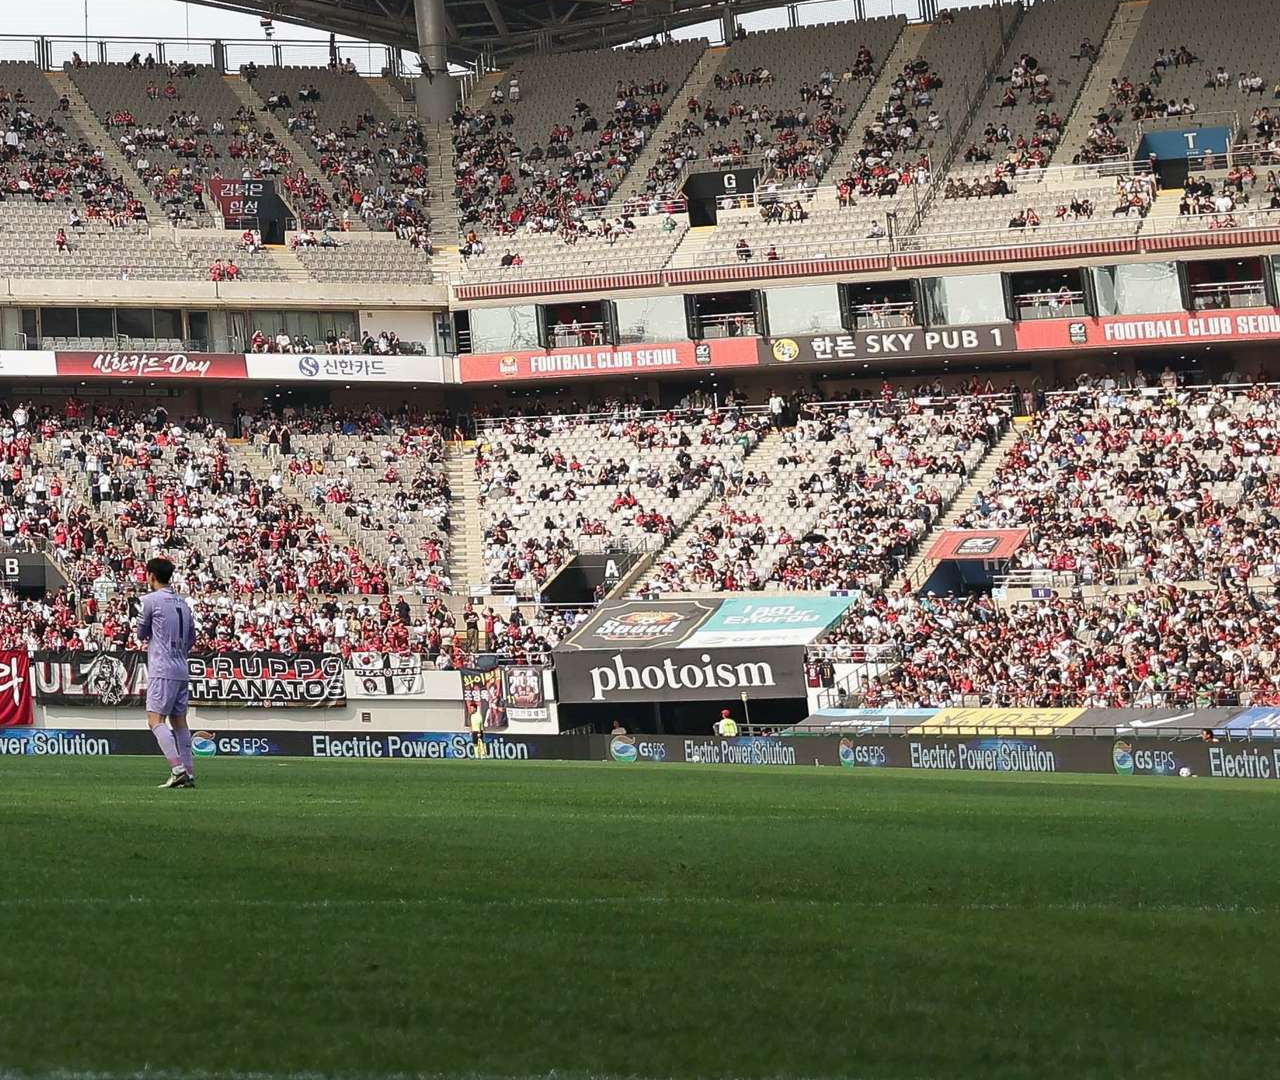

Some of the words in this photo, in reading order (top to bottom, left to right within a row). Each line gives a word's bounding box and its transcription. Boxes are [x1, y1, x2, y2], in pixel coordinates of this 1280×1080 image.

[1184, 132, 1197, 148] T
[723, 173, 736, 188] G
[1104, 321, 1185, 341] FOOTBALL
[1188, 317, 1232, 336] CLUB
[811, 336, 857, 359] 한돈
[866, 333, 914, 353] SKY
[925, 329, 979, 350] PUB
[989, 328, 1003, 346] 1
[93, 352, 162, 376] 신한카드
[164, 353, 211, 376] Day
[323, 358, 386, 375] 신한카드
[530, 353, 595, 373] FOOTBALL
[597, 351, 632, 369] CLUB
[637, 348, 680, 367] SEOUL
[5, 558, 19, 575] B
[605, 560, 619, 577] A
[175, 607, 184, 638] 1
[595, 620, 682, 634] Seoul
[187, 657, 344, 679] GRUPPO
[590, 653, 777, 701] photoism
[190, 678, 347, 700] THANATOS
[34, 733, 110, 755] Solution
[218, 737, 241, 751] GS
[244, 738, 269, 752] EPS
[312, 736, 382, 758] Electric
[388, 737, 447, 758] Power
[452, 737, 528, 759] Soution
[639, 742, 653, 756] GS
[653, 743, 666, 758] EPS
[684, 739, 720, 763] Electric
[721, 740, 752, 764] Power
[755, 741, 795, 765] Solution
[855, 745, 869, 760] GS
[870, 746, 886, 763] EPS
[910, 743, 956, 769] Electric
[959, 744, 999, 770] Power
[1001, 745, 1055, 772] Solution
[1135, 751, 1153, 768] GS
[1154, 752, 1176, 770] EPS
[1209, 748, 1270, 777] Electric
